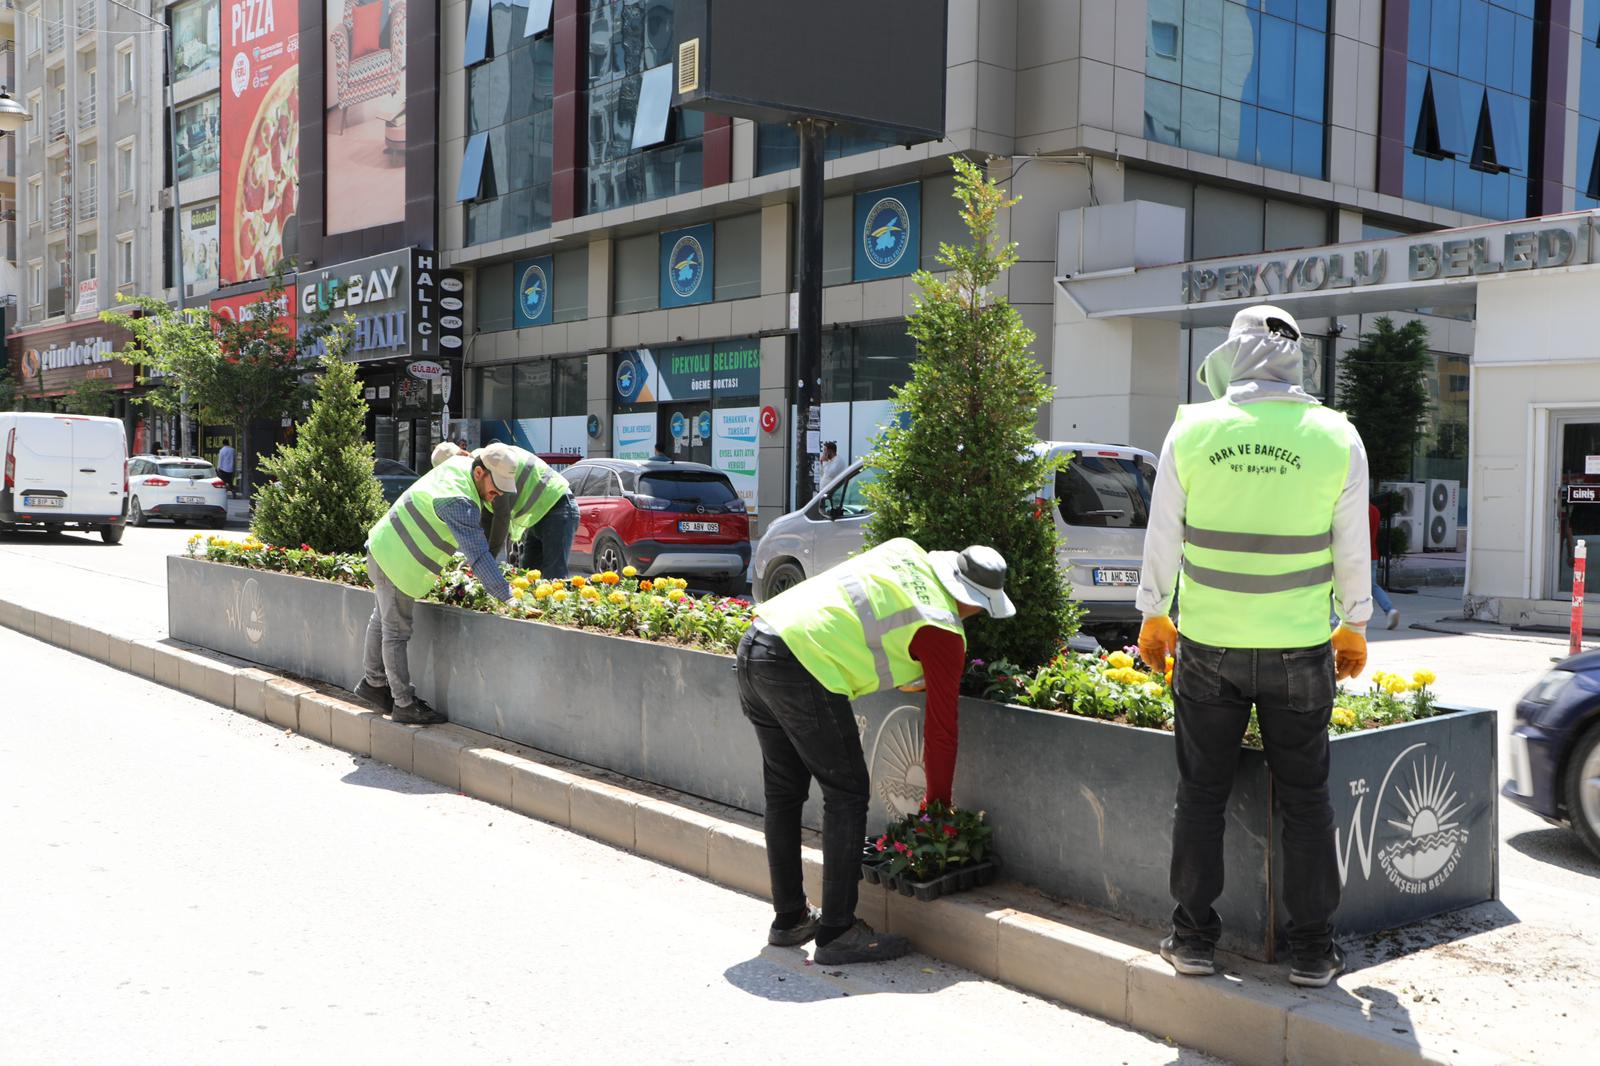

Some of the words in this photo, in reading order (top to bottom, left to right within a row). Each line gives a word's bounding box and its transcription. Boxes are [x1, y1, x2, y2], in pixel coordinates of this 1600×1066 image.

[301, 265, 400, 314] GÜLBAY
[411, 363, 441, 374] GÜLBAY
[671, 352, 711, 375] İPEKYOLU
[691, 378, 711, 391] ÖDEME
[713, 377, 739, 390] NOKTASI
[1208, 446, 1236, 466] PARK
[1237, 443, 1251, 455] VE
[1572, 487, 1596, 501] GİRİŞ
[682, 522, 690, 530] 65
[1098, 571, 1108, 582] 21
[1111, 571, 1123, 582] AHC
[1125, 571, 1137, 582] 590
[1349, 778, 1370, 797] T.C.
[1377, 849, 1428, 895] BÜYÜKŞEHİR
[1428, 828, 1470, 891] BELEDİYSİ
